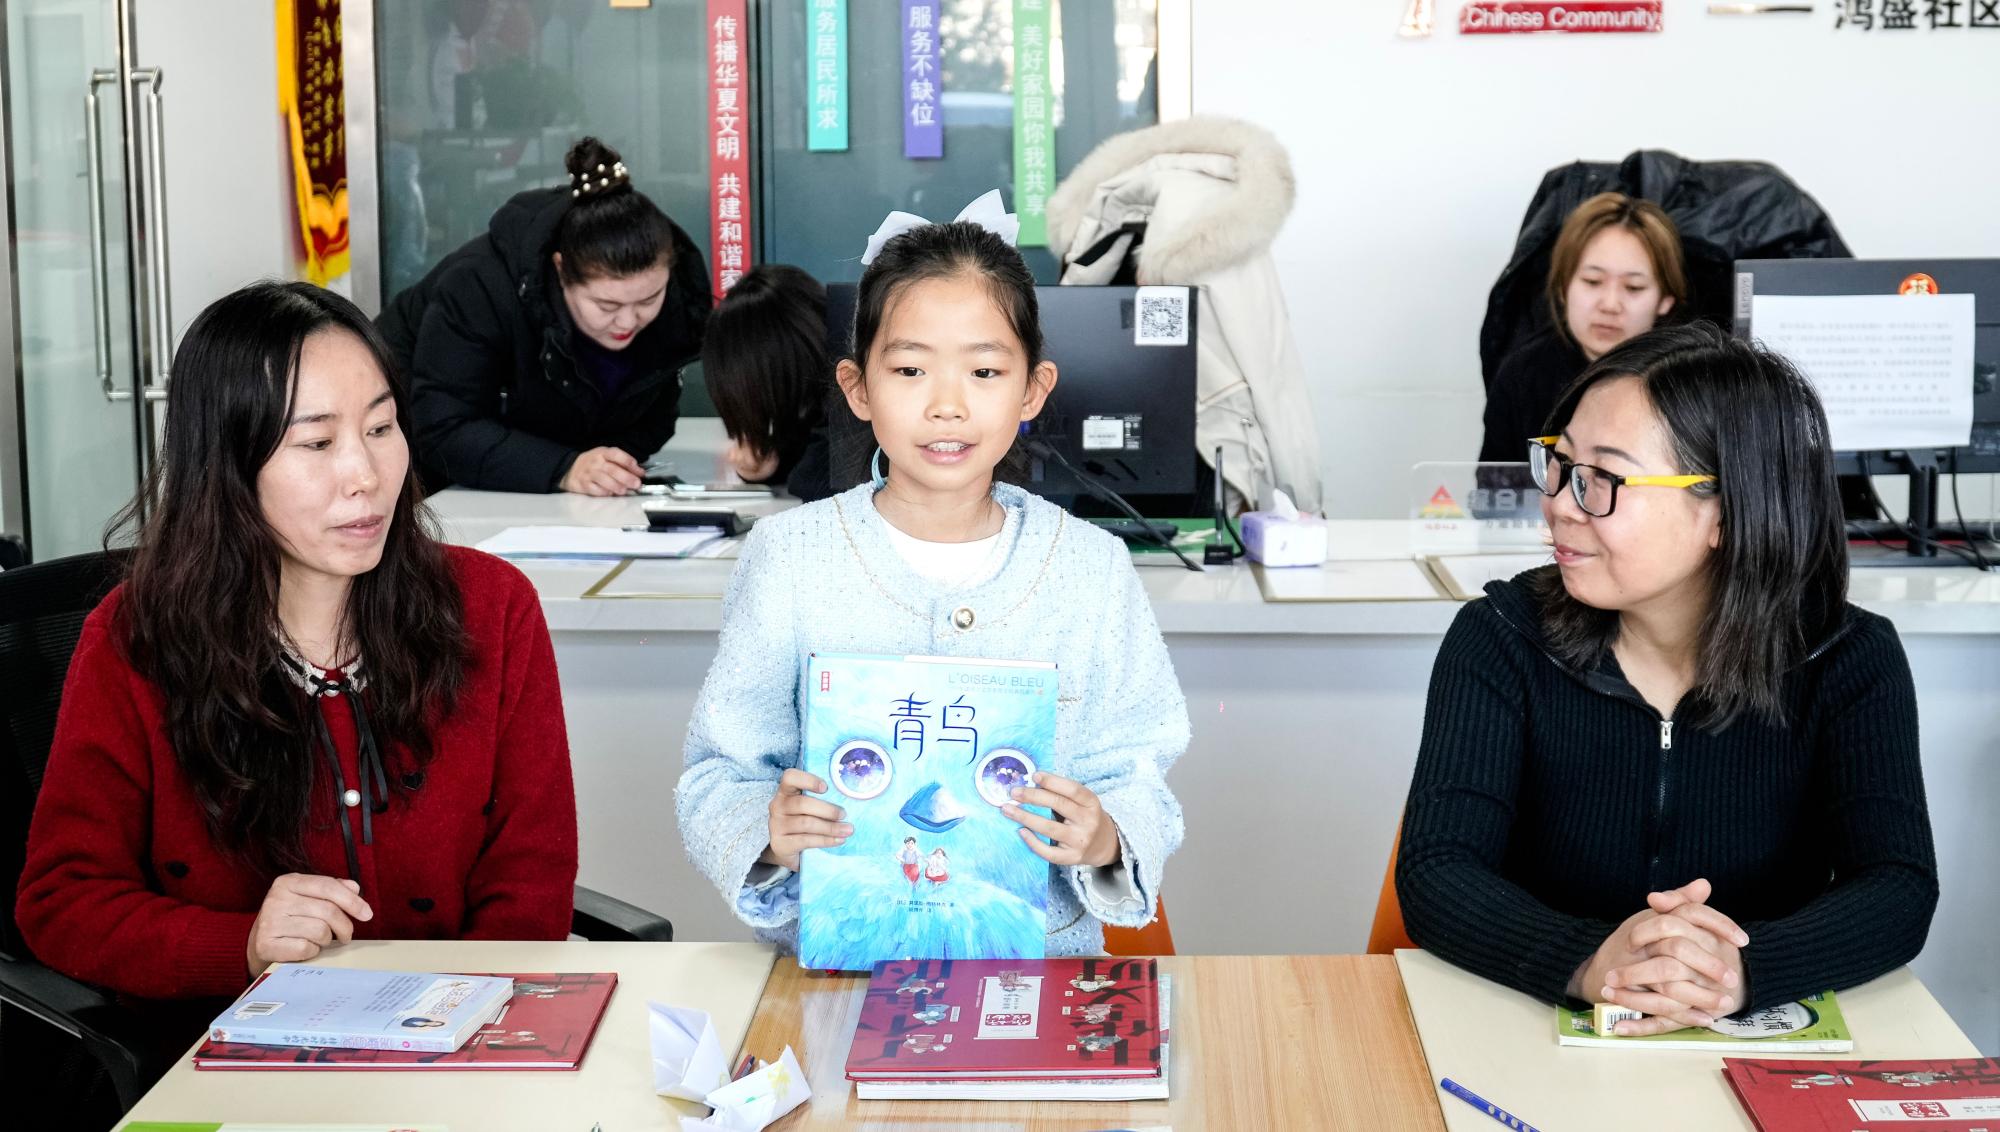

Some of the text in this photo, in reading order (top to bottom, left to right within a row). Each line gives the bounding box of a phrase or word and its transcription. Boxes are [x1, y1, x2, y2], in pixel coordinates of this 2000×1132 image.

[909, 4, 935, 127] 服务不缺位
[1467, 6, 1658, 29] Chinese Community
[714, 15, 740, 161] 传播华夏文明
[1020, 24, 1046, 217] 美好家园你我共享
[888, 691, 979, 767] 青鸟
[1011, 676, 1045, 688] BLEU
